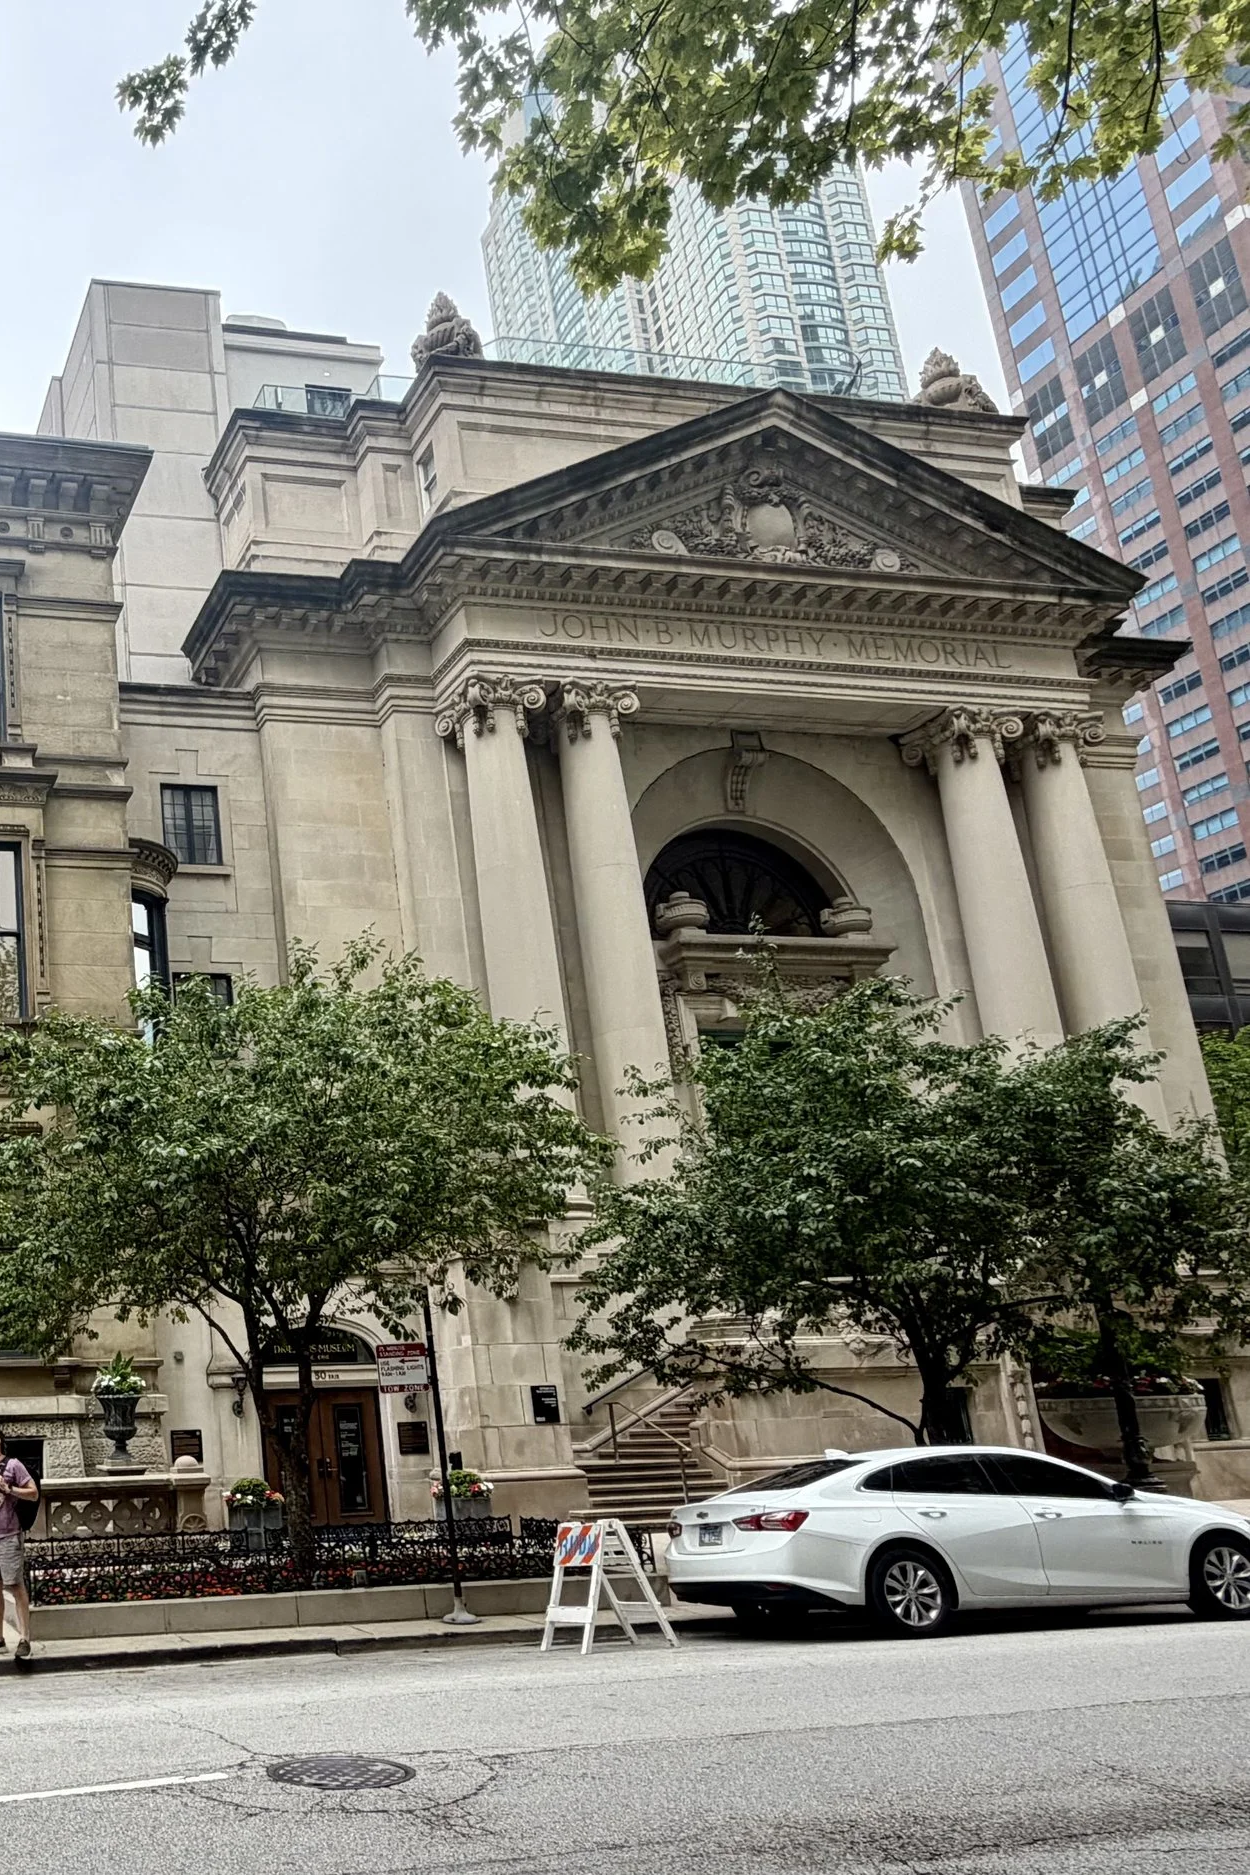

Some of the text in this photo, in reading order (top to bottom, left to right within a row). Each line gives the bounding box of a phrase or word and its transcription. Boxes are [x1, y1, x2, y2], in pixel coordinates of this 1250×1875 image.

[540, 614, 1013, 669] JOHN B MURPHY MEMORIAL
